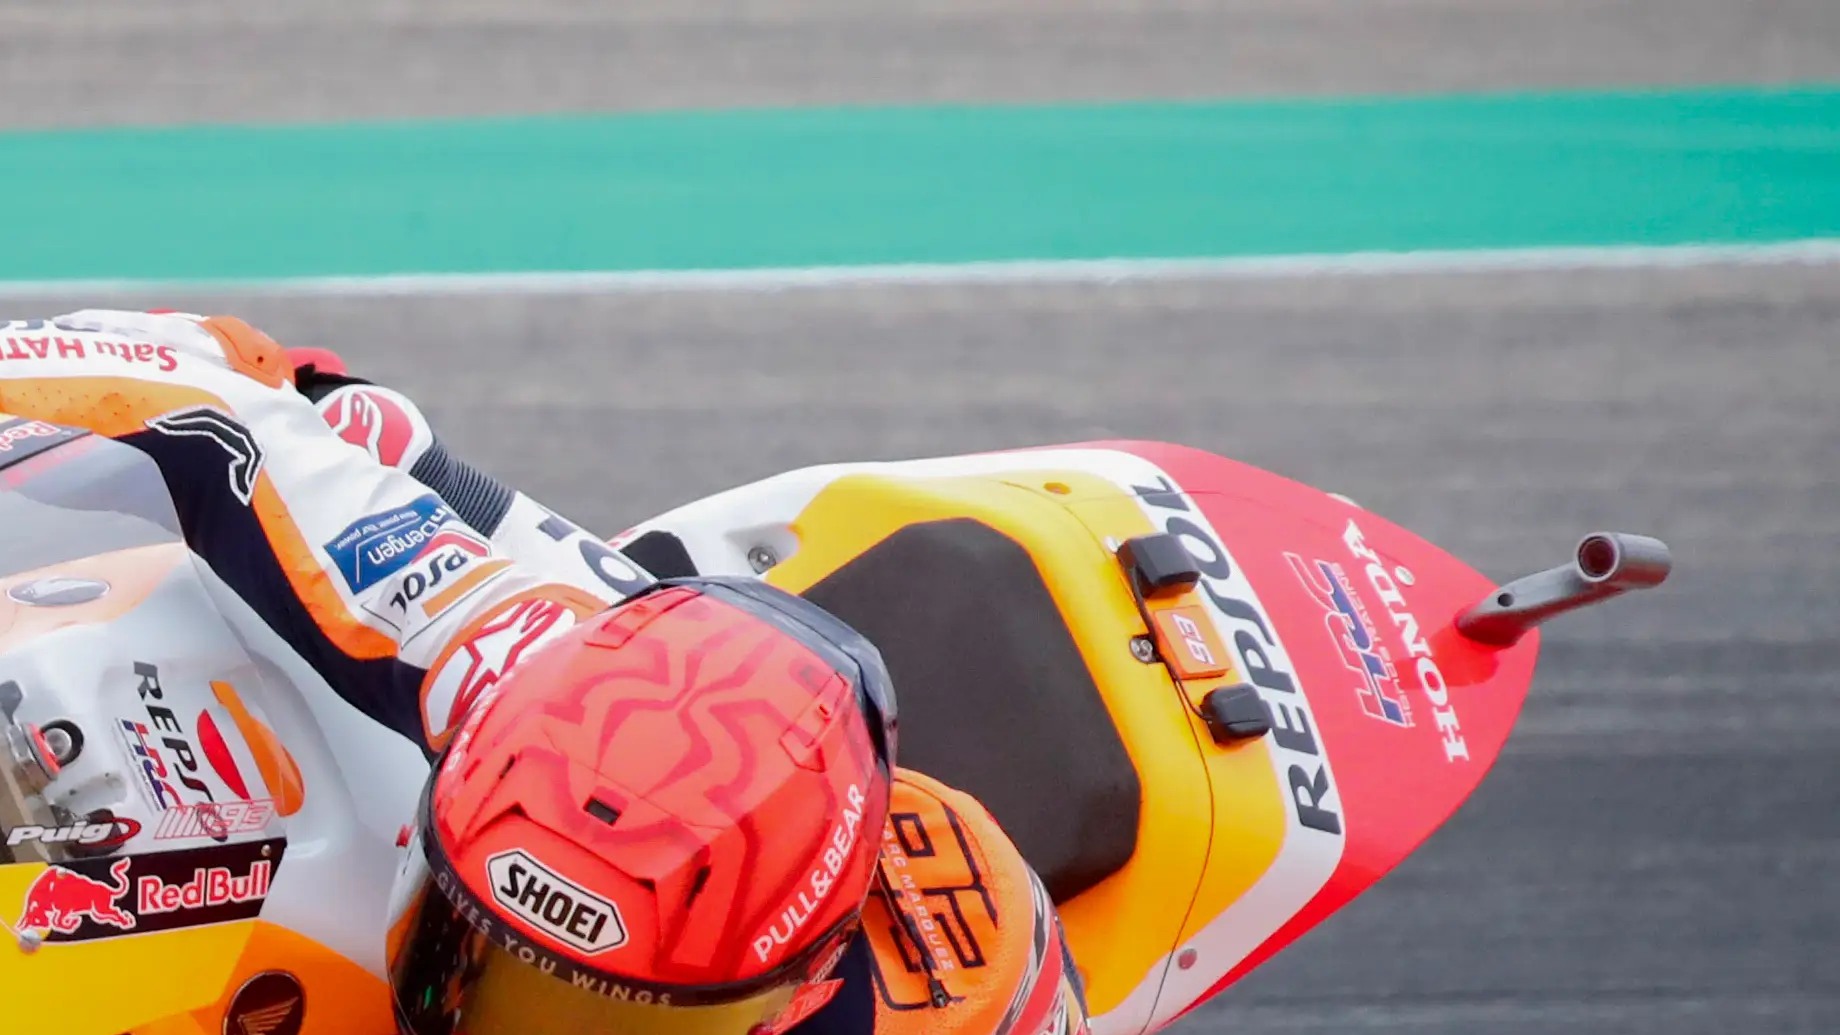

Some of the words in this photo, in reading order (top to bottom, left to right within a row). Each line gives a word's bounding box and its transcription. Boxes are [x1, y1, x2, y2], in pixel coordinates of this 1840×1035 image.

[95, 341, 177, 371] Satu
[390, 551, 469, 612] PSOL
[1130, 475, 1342, 836] REPSOL
[1346, 519, 1469, 763] HONDA
[7, 818, 112, 846] Puig
[500, 862, 609, 945] SHOEI
[753, 784, 864, 962] PULL&BEAR
[503, 934, 555, 974] YOU
[572, 971, 673, 1006] WINGS
